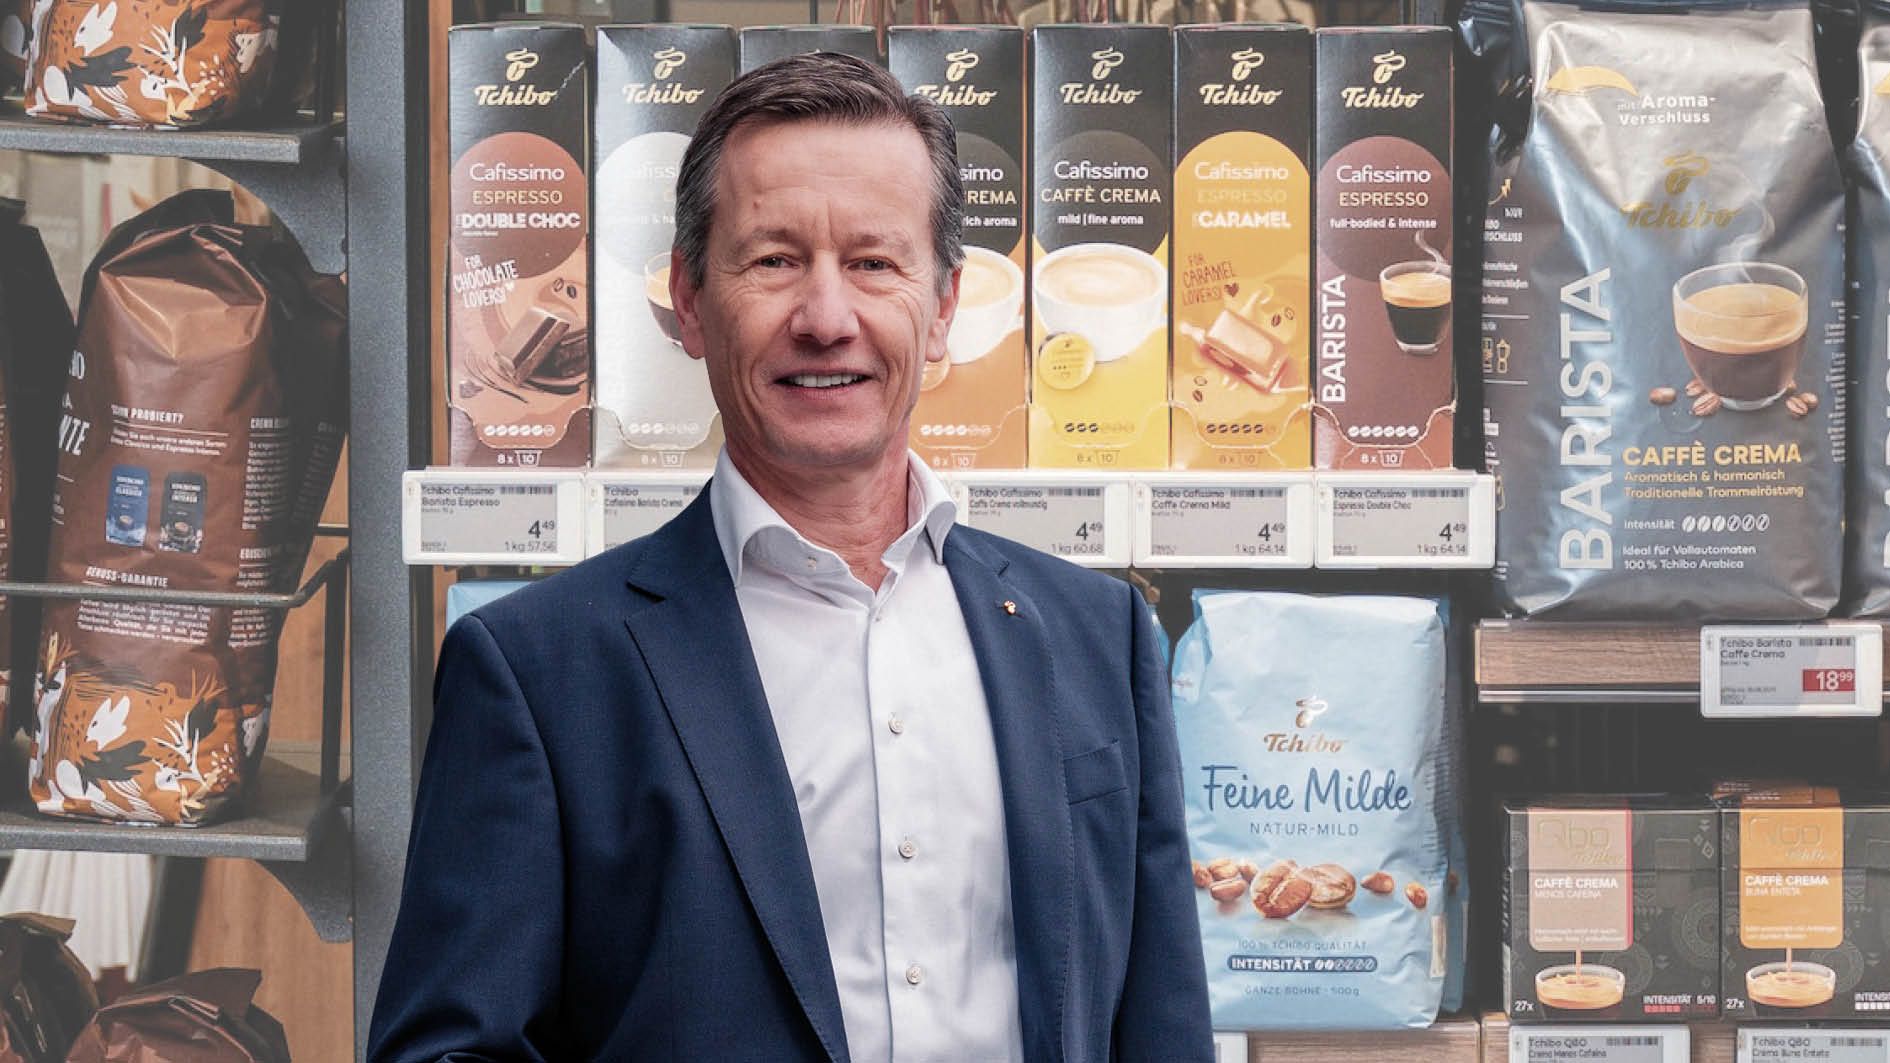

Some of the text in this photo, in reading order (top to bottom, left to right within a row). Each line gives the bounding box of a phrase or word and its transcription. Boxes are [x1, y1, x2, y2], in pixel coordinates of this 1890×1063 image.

[474, 84, 558, 106] Tchibo
[622, 83, 704, 104] Tchibo
[1060, 83, 1143, 104] Tchibo
[1199, 84, 1283, 105] Tchibo
[1341, 87, 1425, 109] Tchibo
[1641, 94, 1716, 110] Aroma-
[1619, 111, 1711, 126] Verschluss
[469, 162, 565, 182] Cafissimo
[1054, 160, 1149, 180] Cafissimo
[1194, 161, 1289, 181] Cafissimo
[1336, 164, 1432, 184] Cafissimo
[473, 190, 563, 205] ESPRESSO
[962, 190, 1018, 205] REMA
[1040, 185, 1161, 203] CAFFÈ CREMA
[1197, 188, 1287, 204] ESPRESSO
[1339, 192, 1429, 207] ESPRESSO
[459, 212, 580, 229] DOUBLE CHOC
[983, 217, 1018, 227] aroma
[1057, 213, 1081, 226] mild
[1110, 215, 1144, 225] aroma
[1198, 211, 1291, 229] CARAMEL
[1619, 201, 1742, 229] Tchibo
[1330, 217, 1437, 230] full-bodied & intense
[454, 260, 519, 292] CHOCOLATE
[1183, 261, 1236, 288] CARAMEL
[1322, 274, 1347, 402] BARISTA
[1560, 266, 1613, 569] BARISTA
[522, 454, 534, 464] 10
[1385, 453, 1398, 463] 10
[1622, 440, 1802, 466] CAFFÈ CREMA
[1624, 469, 1785, 483] Aromatisch & harmonisch
[1624, 485, 1804, 498] Traditionelle Trommelröstung
[459, 497, 500, 507] Espresso
[1624, 518, 1675, 529] Intensität
[1623, 545, 1757, 556] Ideal für Vollautomaten
[1624, 560, 1645, 571] 100
[1659, 559, 1698, 569] Tchibo
[1699, 559, 1744, 569] Arabica
[1720, 638, 1792, 647] Tchibo Barista
[1751, 650, 1785, 658] Crema
[1264, 733, 1344, 753] Tchibo
[1201, 764, 1294, 812] Feine
[1304, 767, 1412, 813] Milde
[1250, 822, 1359, 836] NATUR-MILD
[1575, 878, 1619, 889] CREMA
[1785, 875, 1829, 886] CREMA
[1231, 956, 1312, 971] INTENSITÄT
[1245, 985, 1280, 995] GANZE
[1284, 985, 1321, 995] BOHNE
[1515, 1000, 1534, 1012] 27x
[1726, 998, 1745, 1009] 27x
[1528, 1038, 1561, 1047] Tchibo
[1752, 1037, 1785, 1046] Tchibo
